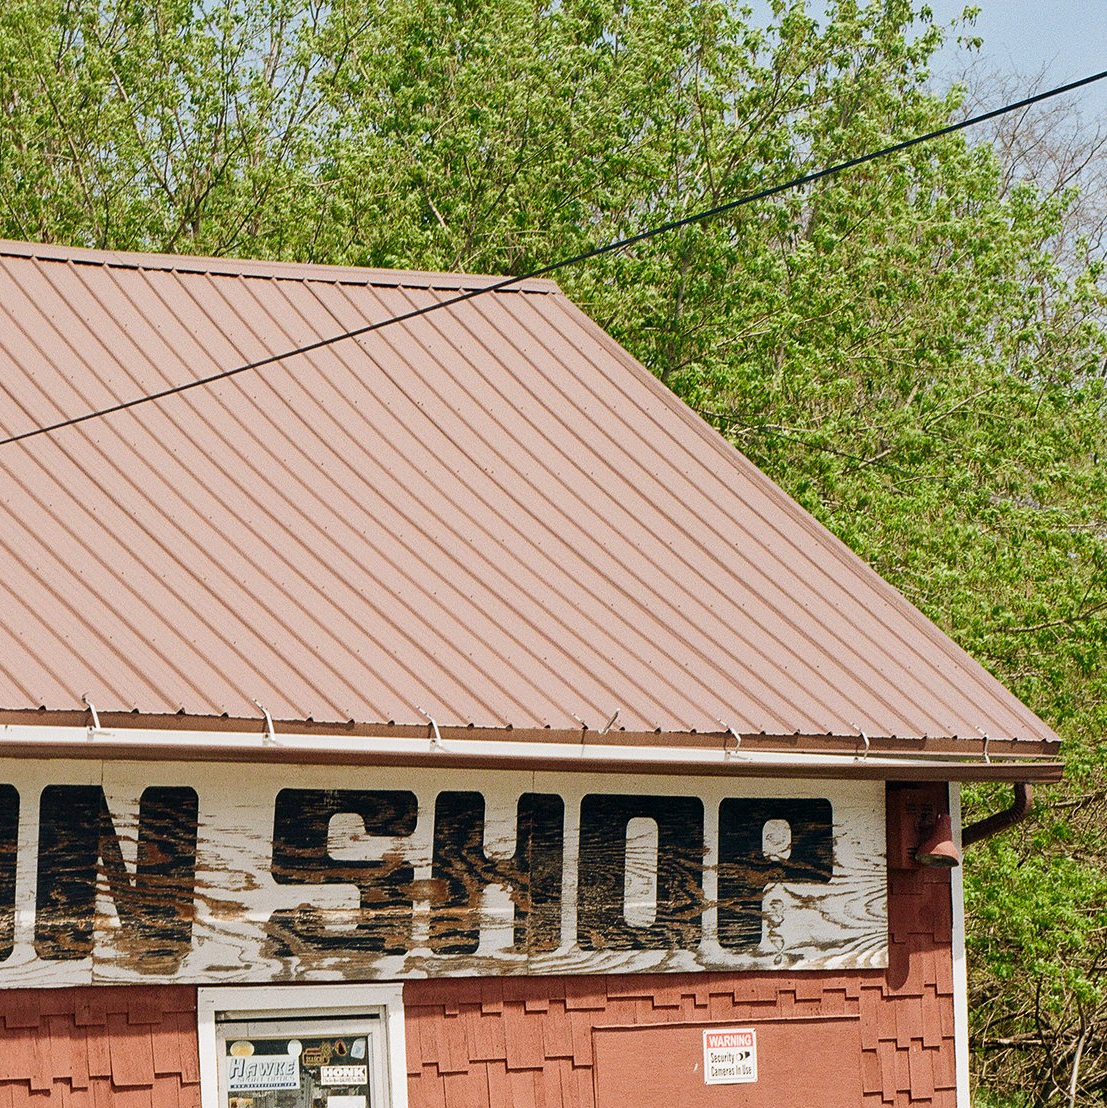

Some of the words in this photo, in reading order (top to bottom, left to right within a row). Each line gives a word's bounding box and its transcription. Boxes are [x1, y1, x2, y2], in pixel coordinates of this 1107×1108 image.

[266, 787, 834, 957] SHOP
[709, 1034, 751, 1048] WARNING
[710, 1052, 735, 1063] Security
[323, 1067, 366, 1078] HONK
[711, 1065, 735, 1076] Cameras
[742, 1064, 752, 1075] Use
